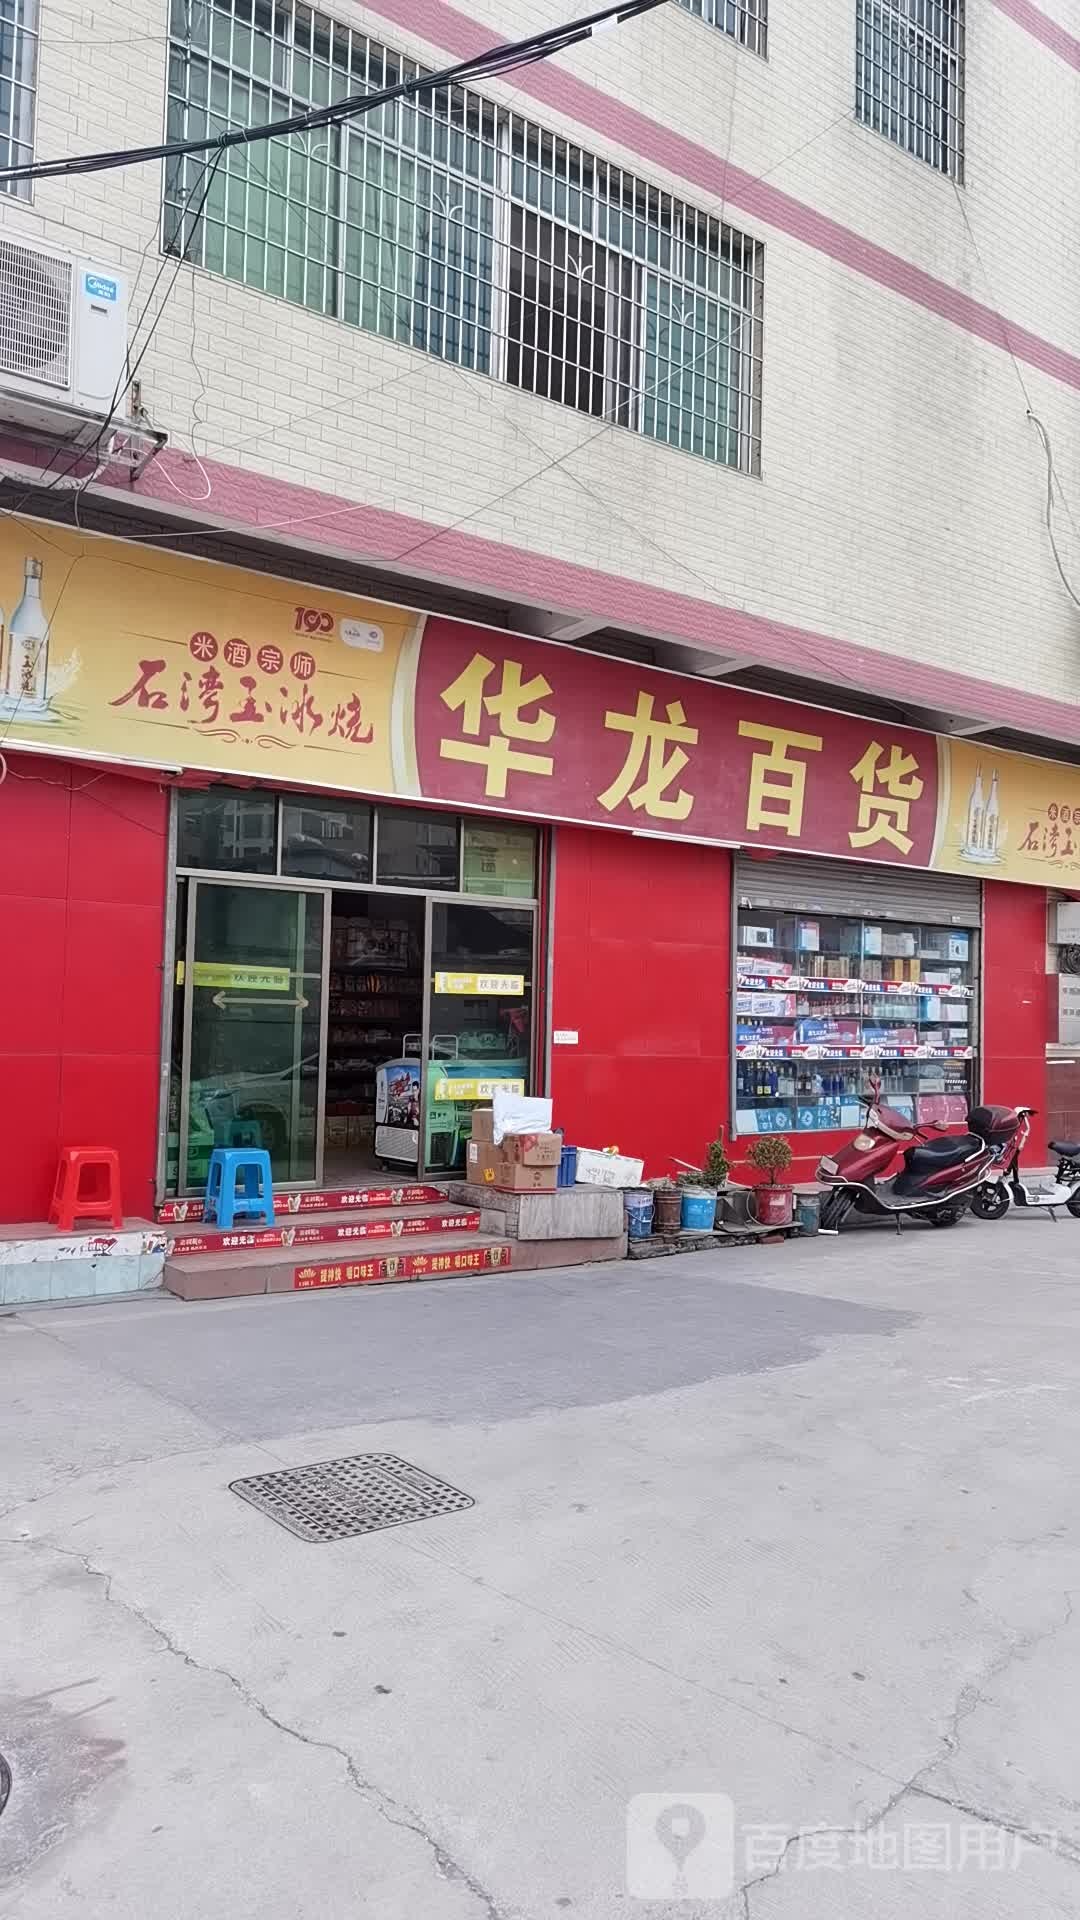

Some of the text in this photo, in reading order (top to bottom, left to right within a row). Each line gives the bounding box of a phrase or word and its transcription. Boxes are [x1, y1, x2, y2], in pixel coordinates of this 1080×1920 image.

[191, 632, 315, 679] 米酒宗师
[108, 659, 374, 744] 石湾玉冰烧
[440, 652, 925, 856] 华龙百货
[341, 1194, 368, 1204] 欢迎光临
[441, 1217, 467, 1228] 欢迎光临
[337, 1226, 367, 1238] 欢迎光临
[222, 1234, 255, 1247] 欢迎光临
